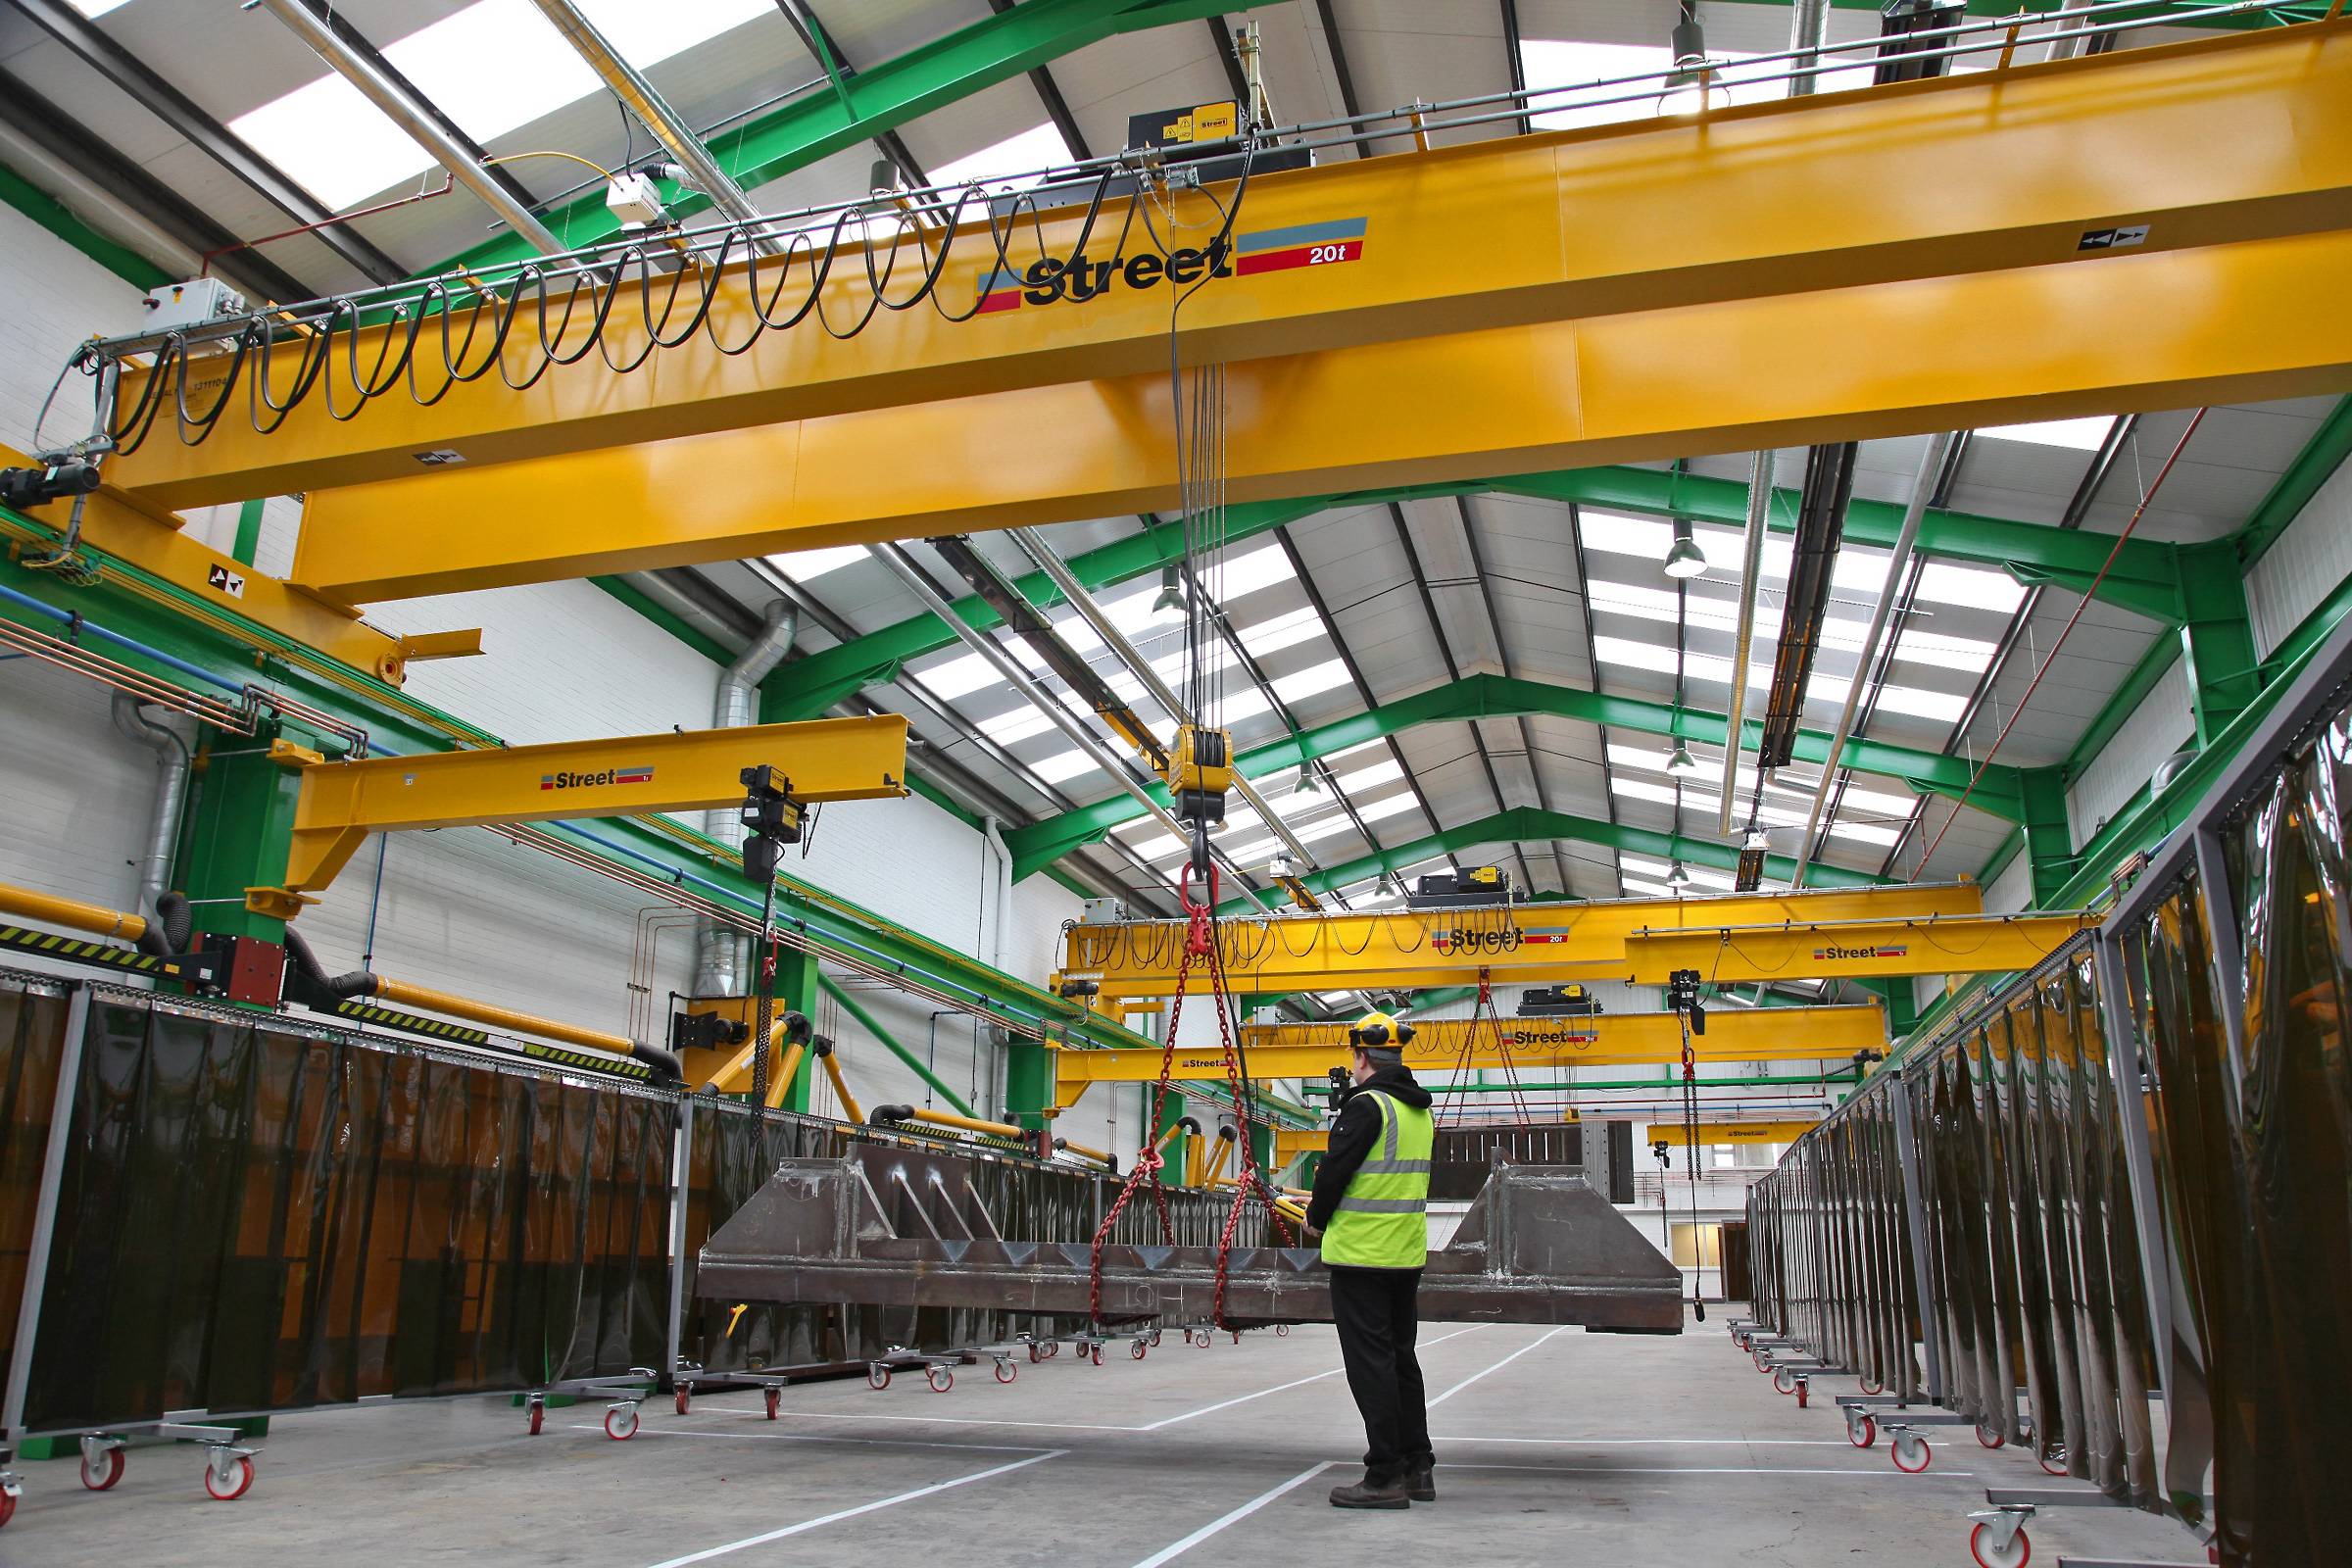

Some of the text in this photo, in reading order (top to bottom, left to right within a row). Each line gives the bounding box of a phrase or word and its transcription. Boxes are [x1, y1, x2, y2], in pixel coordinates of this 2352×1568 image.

[1024, 236, 1347, 306] Street 20t
[556, 768, 615, 789] Street
[1449, 926, 1524, 948] Street
[1826, 946, 1876, 959] Street
[1514, 1030, 1567, 1045] Street
